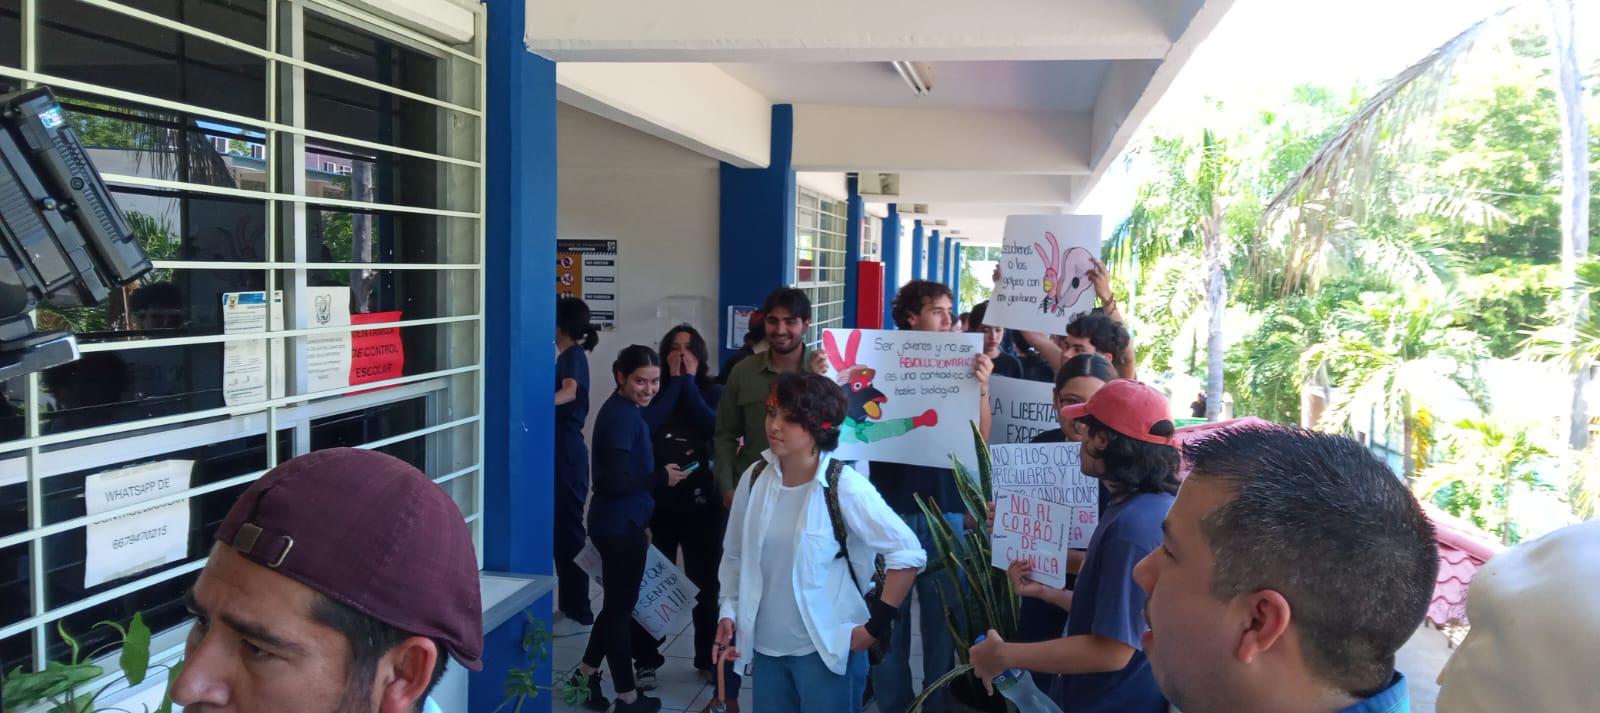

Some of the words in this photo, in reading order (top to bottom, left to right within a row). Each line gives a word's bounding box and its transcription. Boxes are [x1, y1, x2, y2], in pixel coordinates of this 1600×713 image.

[1026, 278, 1040, 288] con
[351, 347, 363, 359] DE
[364, 343, 399, 358] CONTROL
[873, 337, 895, 351] Ser
[935, 344, 943, 357] y
[943, 343, 957, 352] no
[959, 344, 975, 353] ser
[355, 363, 393, 378] ESCOLAR
[883, 372, 898, 382] es
[900, 372, 917, 382] una
[1011, 400, 1058, 423] LIBERTA
[992, 446, 1010, 466] NO
[1024, 446, 1049, 465] LOS
[1058, 467, 1067, 486] Y
[105, 481, 157, 503] WHATSAPP
[158, 478, 171, 490] DE
[1010, 494, 1030, 515] NO
[1036, 503, 1053, 523] AL
[1001, 511, 1053, 542] COBRO
[1021, 535, 1037, 550] DE
